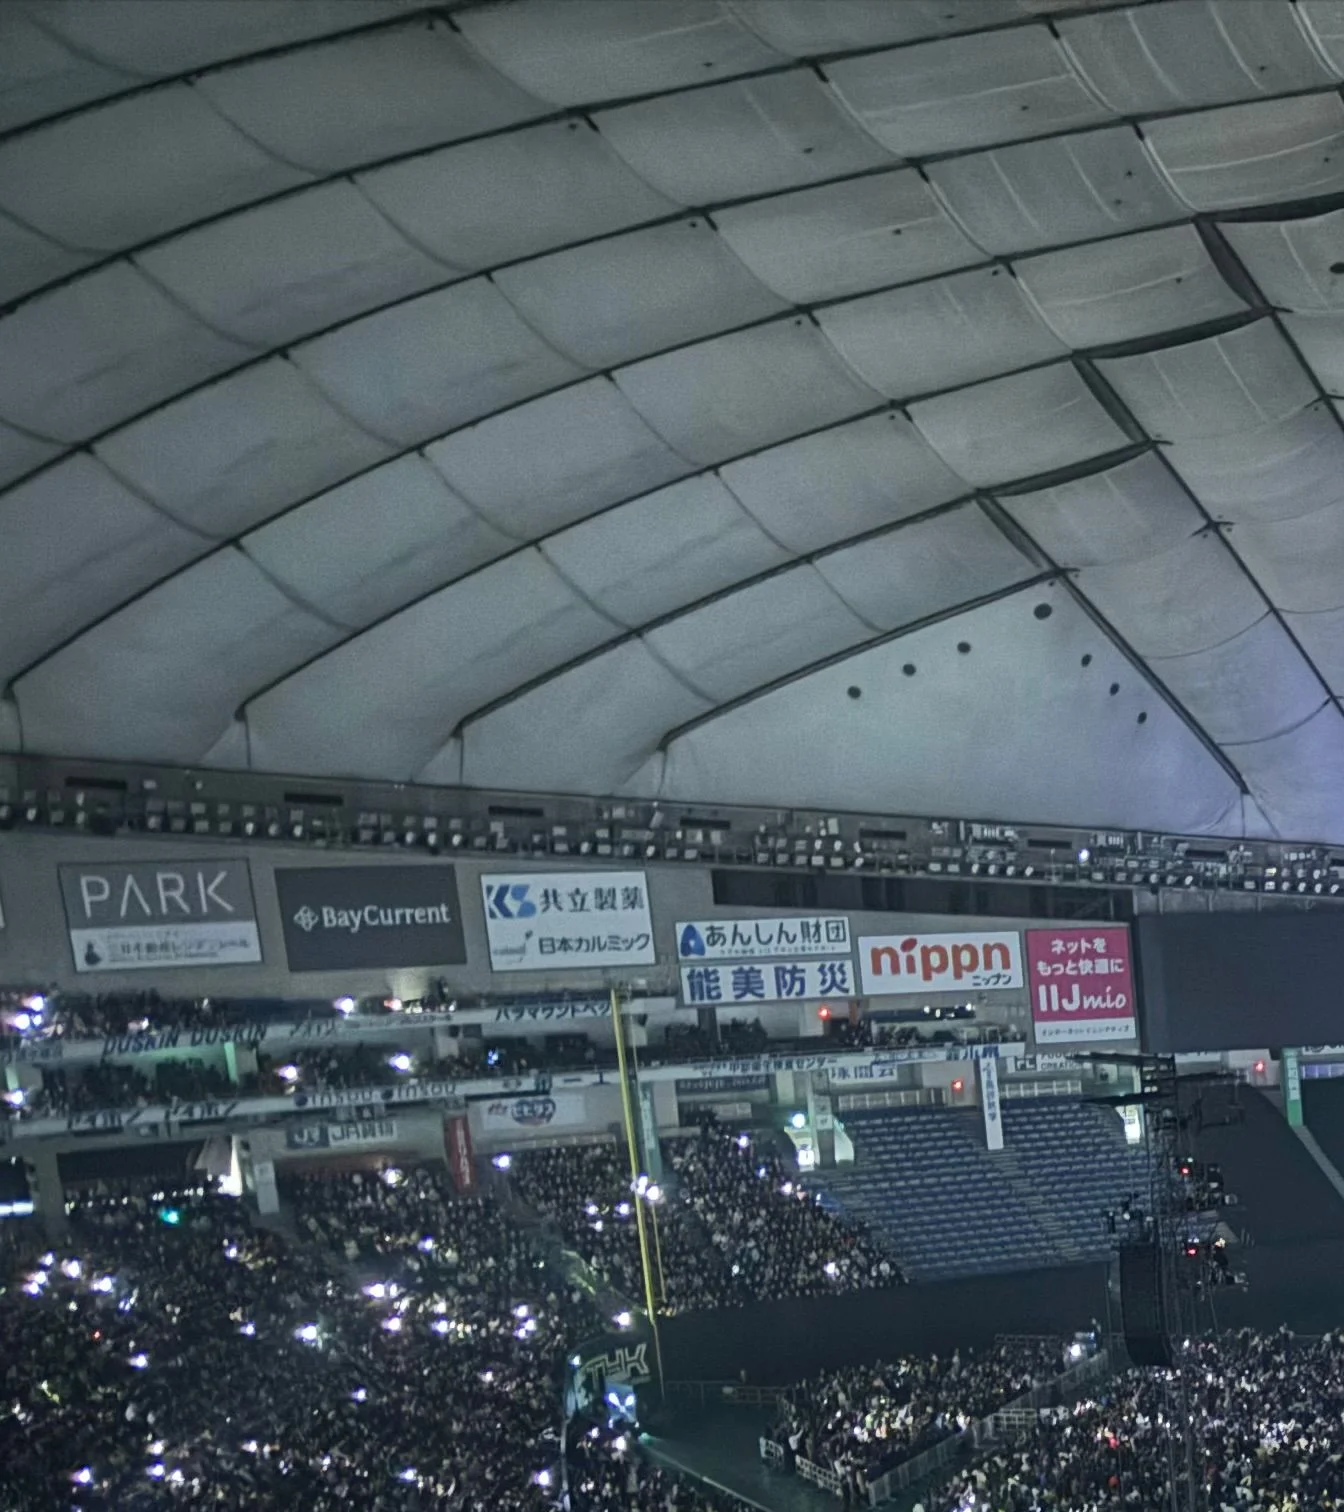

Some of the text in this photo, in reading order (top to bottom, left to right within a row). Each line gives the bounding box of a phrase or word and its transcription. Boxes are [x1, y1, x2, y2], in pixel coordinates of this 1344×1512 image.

[539, 886, 645, 913] 共立製薬
[321, 903, 451, 933] BayCurrent
[538, 932, 650, 955] 日本カルミック
[705, 919, 847, 947] あんしん財団
[1051, 937, 1107, 954] ネットを
[870, 937, 1011, 981] nippn
[1036, 958, 1124, 977] もっと快適に
[687, 963, 850, 1002] 能美防災
[972, 974, 1012, 986] ニップン
[1038, 984, 1126, 1012] IIJmio
[104, 1028, 180, 1053] DUSKIN
[190, 1022, 268, 1046] DUSKIN
